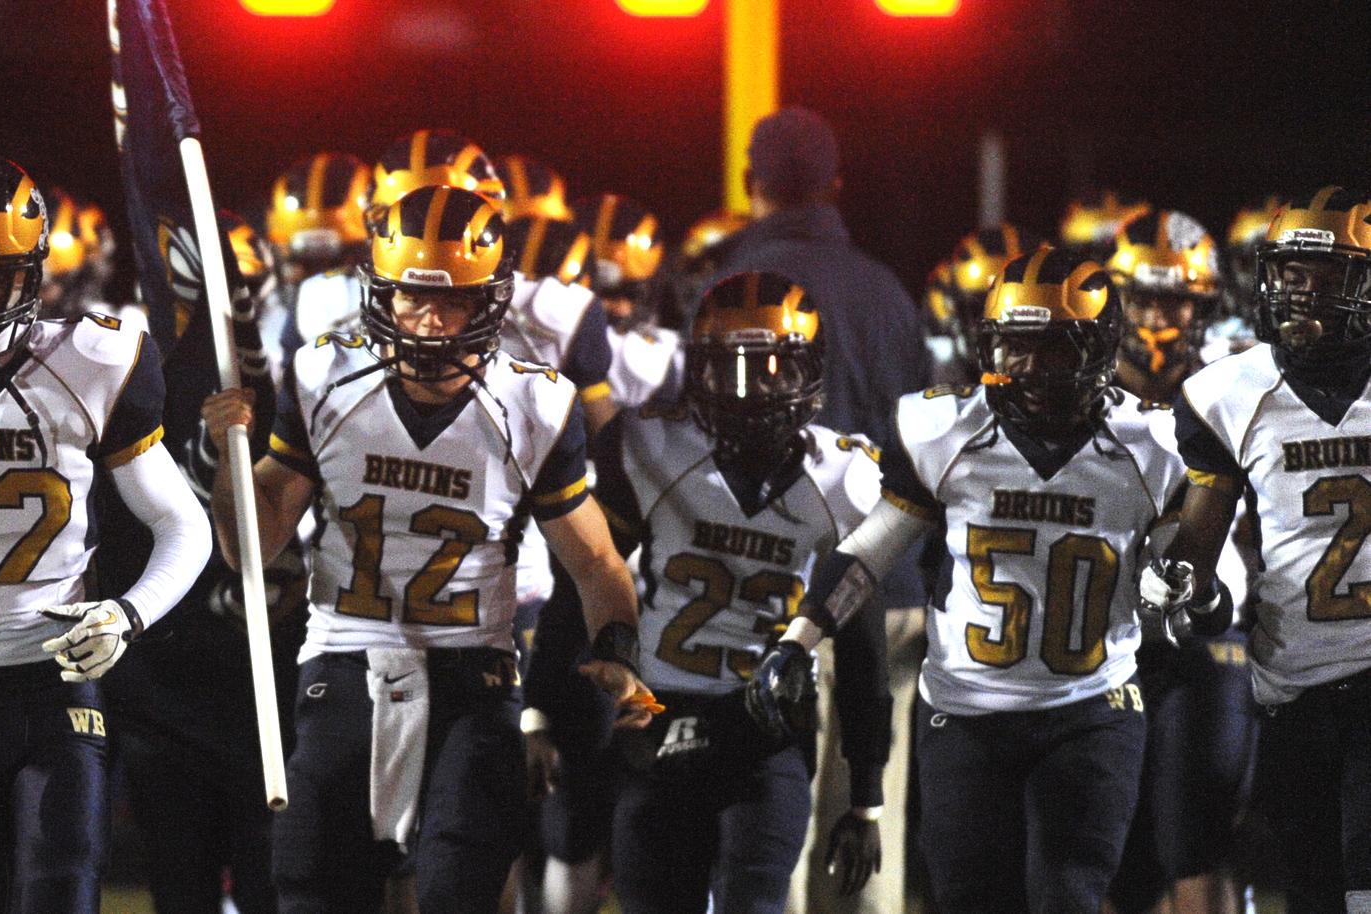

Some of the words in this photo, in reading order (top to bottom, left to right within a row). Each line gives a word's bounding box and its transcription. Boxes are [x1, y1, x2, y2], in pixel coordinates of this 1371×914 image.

[407, 271, 445, 283] Riddell
[1281, 436, 1371, 472] BRUIN
[362, 453, 472, 501] BRUINS
[991, 489, 1093, 529] BRUINS
[334, 493, 490, 626] 12
[691, 518, 797, 566] BRUINS
[965, 523, 1118, 677] 50
[1105, 681, 1145, 713] WB
[66, 706, 107, 737] WB
